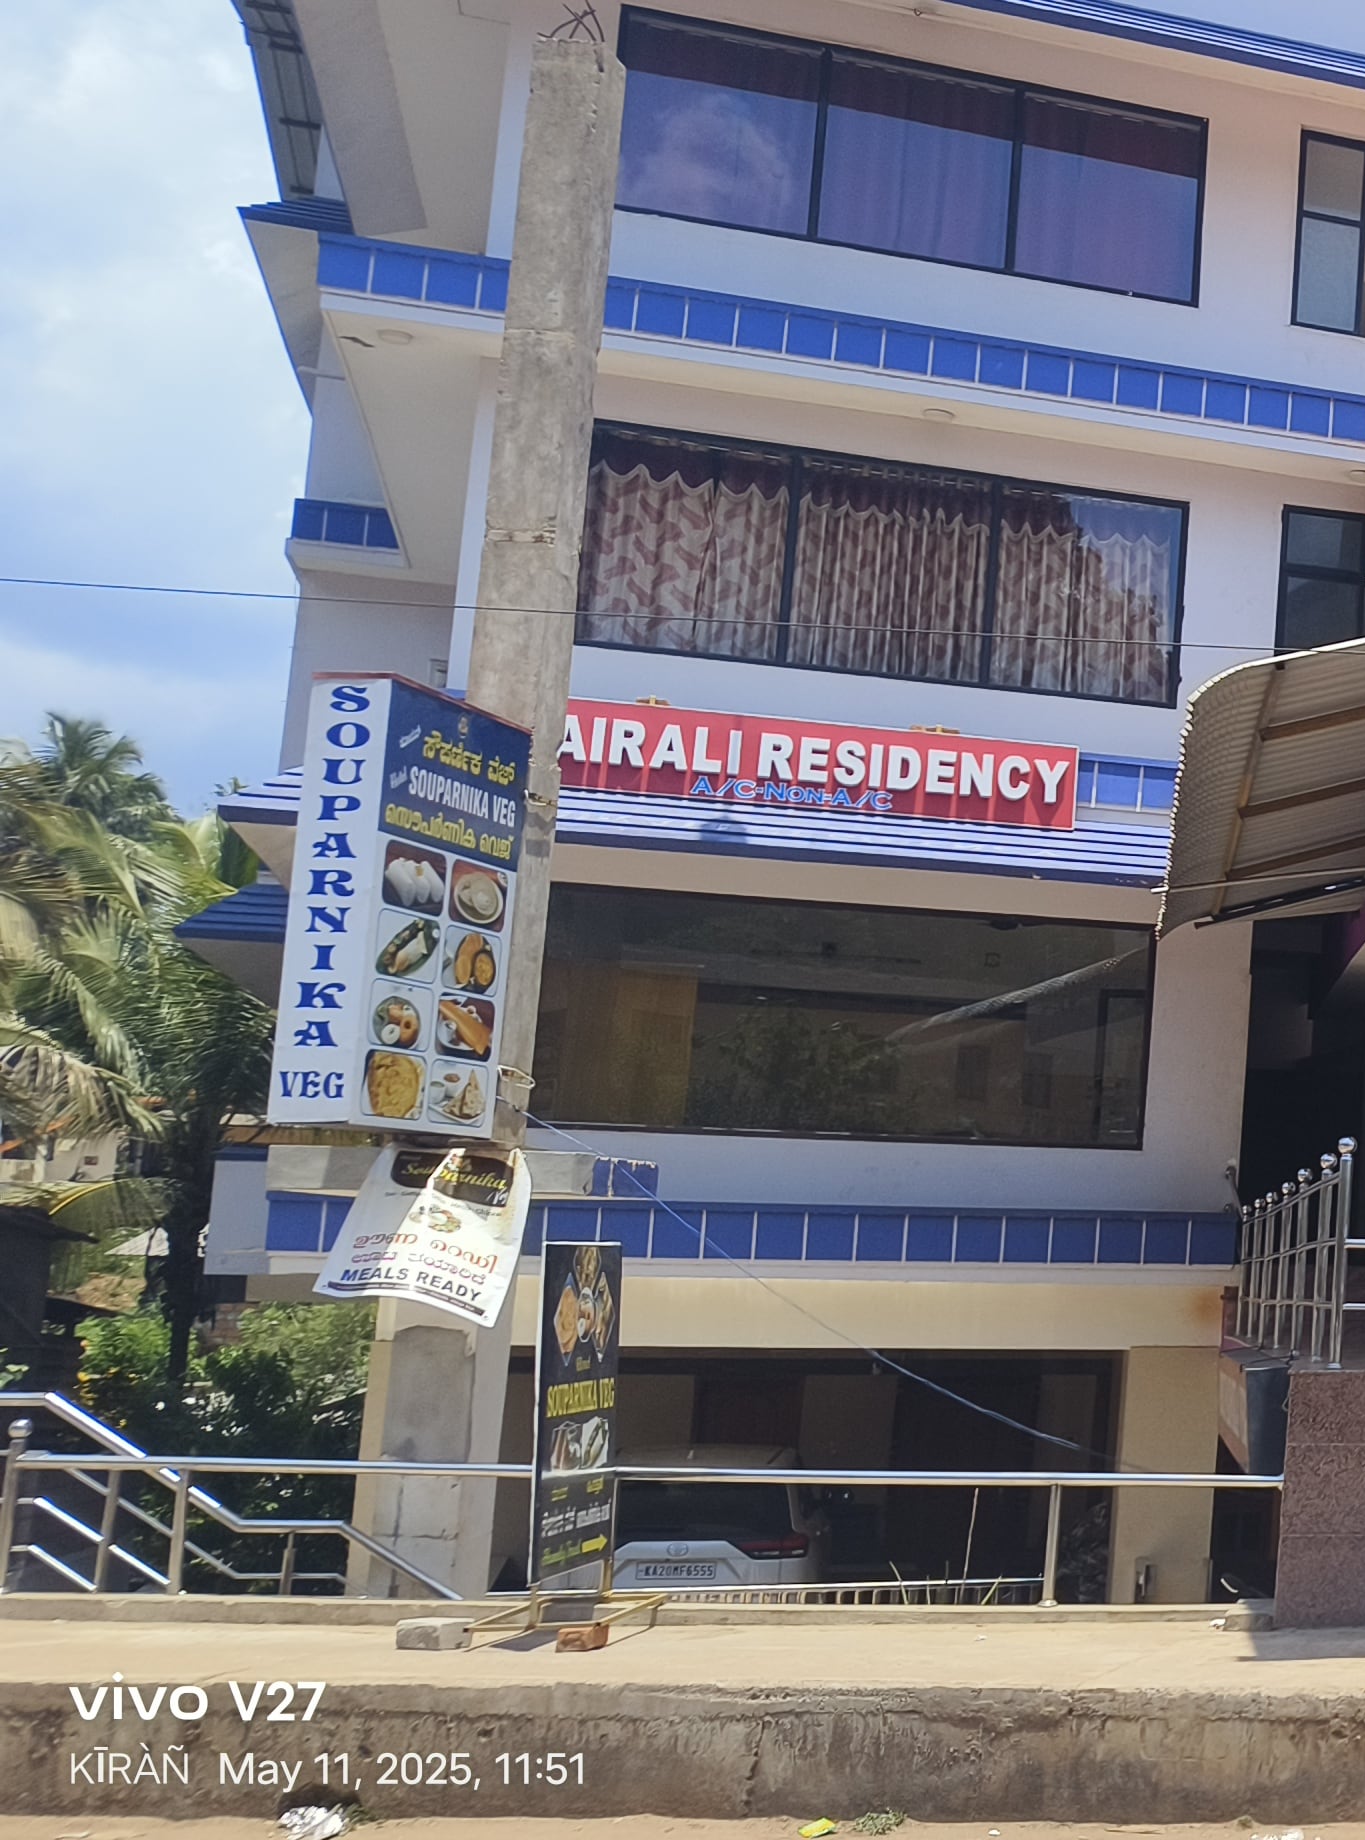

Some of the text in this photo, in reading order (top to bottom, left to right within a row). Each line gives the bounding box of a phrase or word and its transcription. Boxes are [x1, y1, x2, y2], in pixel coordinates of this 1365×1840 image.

[556, 713, 1070, 804] AIRALI RESIDENCY
[408, 766, 489, 819] SOUPARNIKA
[493, 795, 516, 827] VEG
[293, 685, 371, 1047] SOUPARNIKA
[279, 1070, 345, 1099] VEG
[340, 1267, 409, 1282] MEALS
[416, 1271, 482, 1302] READY
